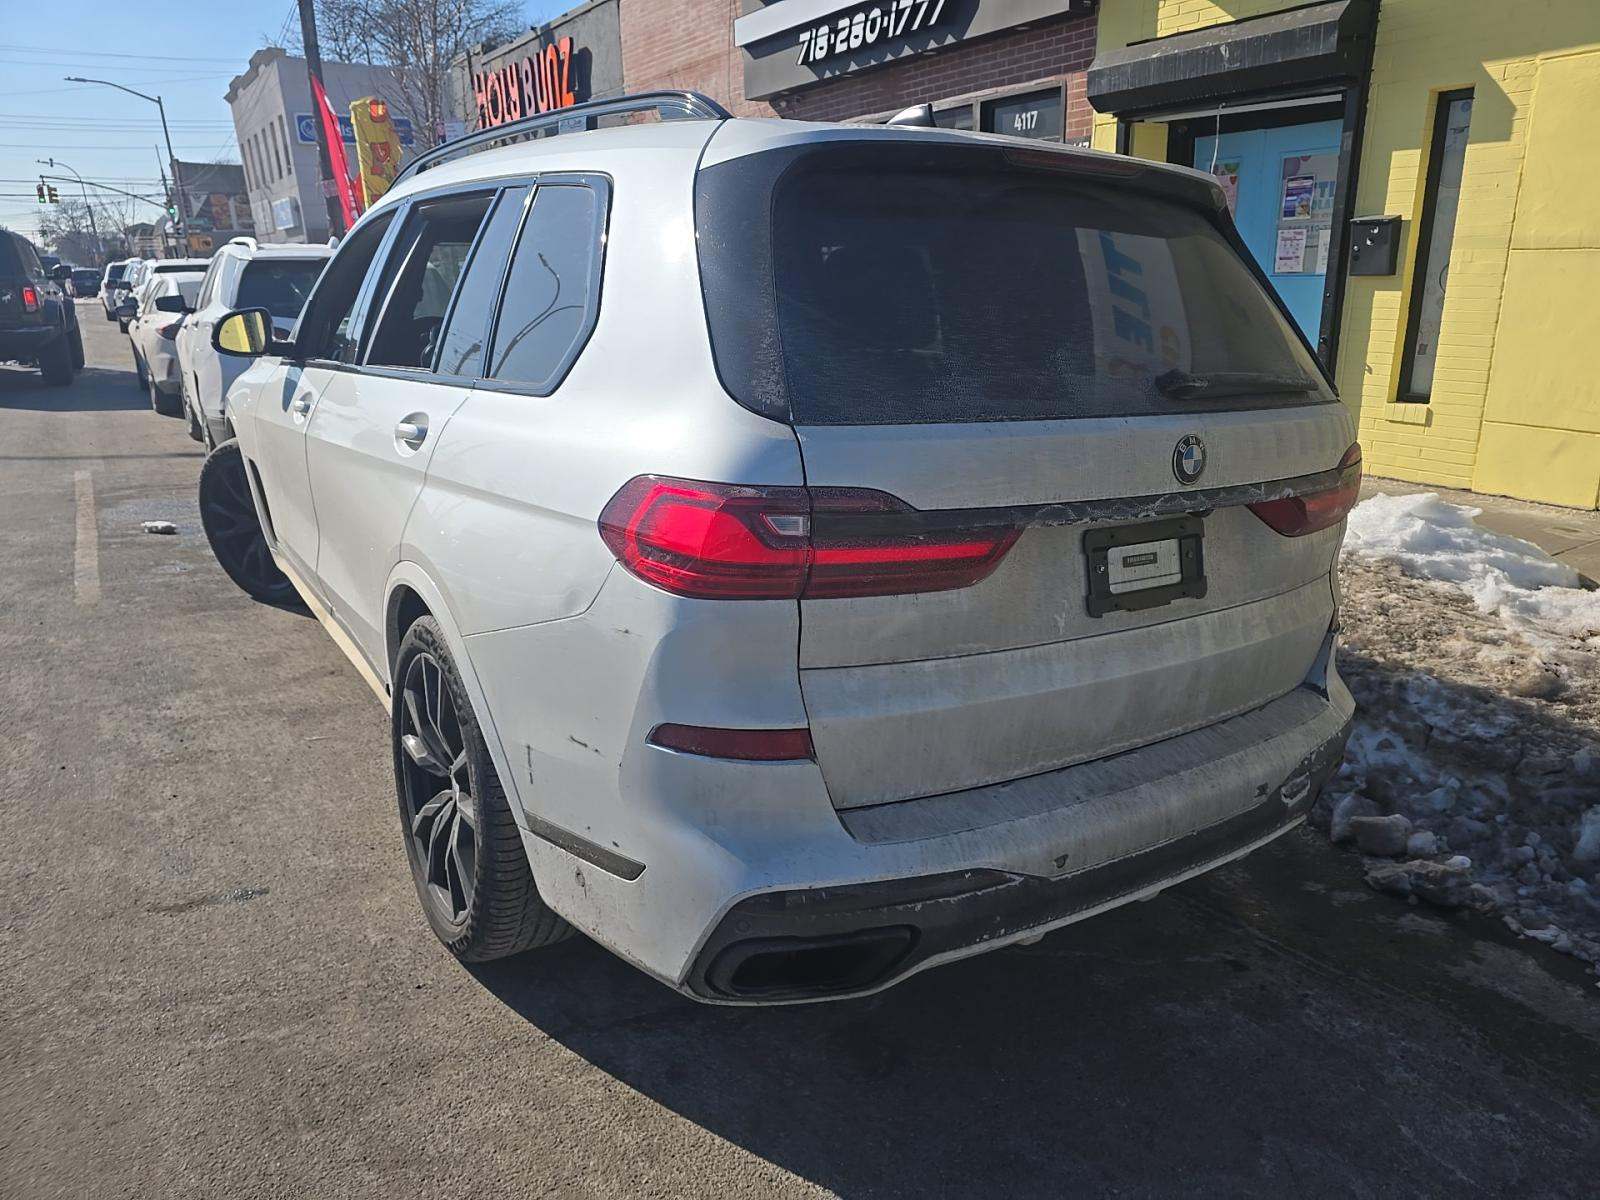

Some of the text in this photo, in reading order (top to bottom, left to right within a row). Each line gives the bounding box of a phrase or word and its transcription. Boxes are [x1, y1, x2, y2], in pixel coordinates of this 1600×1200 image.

[473, 36, 576, 130] HOLY BUNZ
[1014, 110, 1038, 131] 4117
